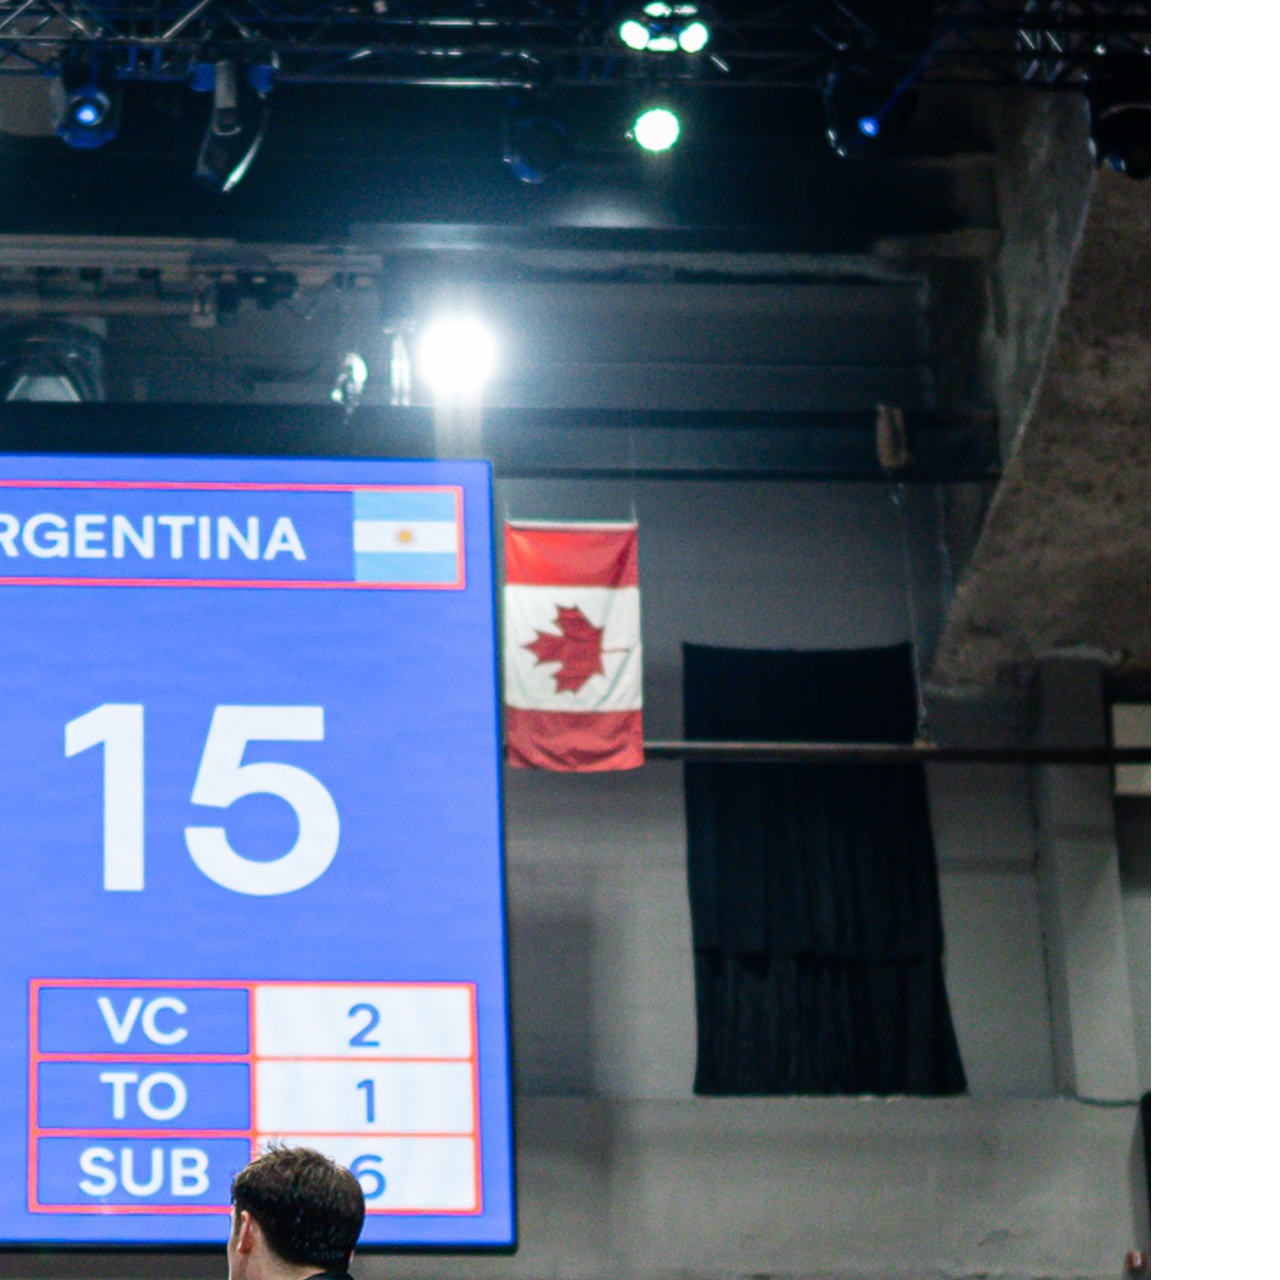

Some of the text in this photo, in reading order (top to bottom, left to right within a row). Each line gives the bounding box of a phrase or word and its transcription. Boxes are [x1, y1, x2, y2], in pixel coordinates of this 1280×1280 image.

[63, 702, 342, 897] 15
[98, 998, 382, 1050] VC 2
[99, 1072, 377, 1124] TO 1
[78, 1146, 387, 1201] SUB 6
